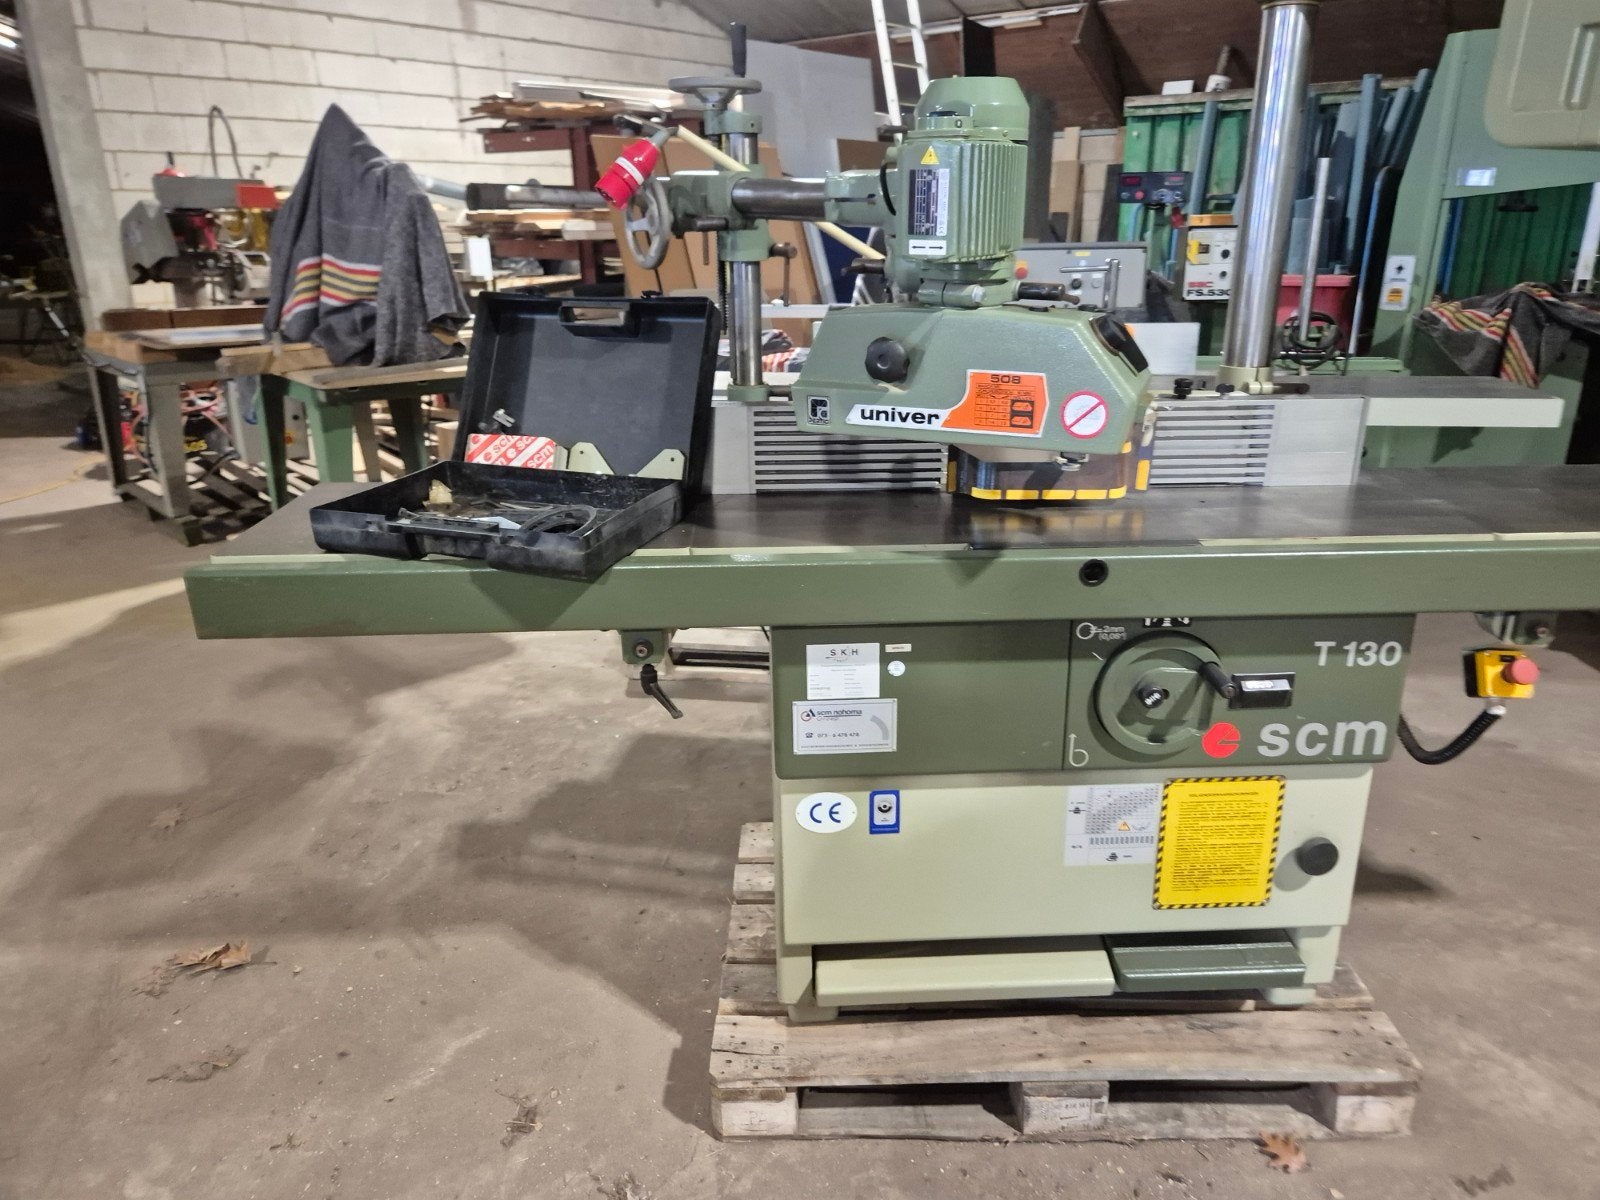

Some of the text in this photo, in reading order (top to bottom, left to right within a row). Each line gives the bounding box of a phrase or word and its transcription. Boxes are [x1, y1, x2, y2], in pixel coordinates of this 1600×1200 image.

[990, 374, 1021, 384] 508
[860, 407, 940, 425] univer
[1314, 641, 1403, 667] T 130
[1257, 720, 1388, 758] scm
[809, 801, 842, 824] CE
